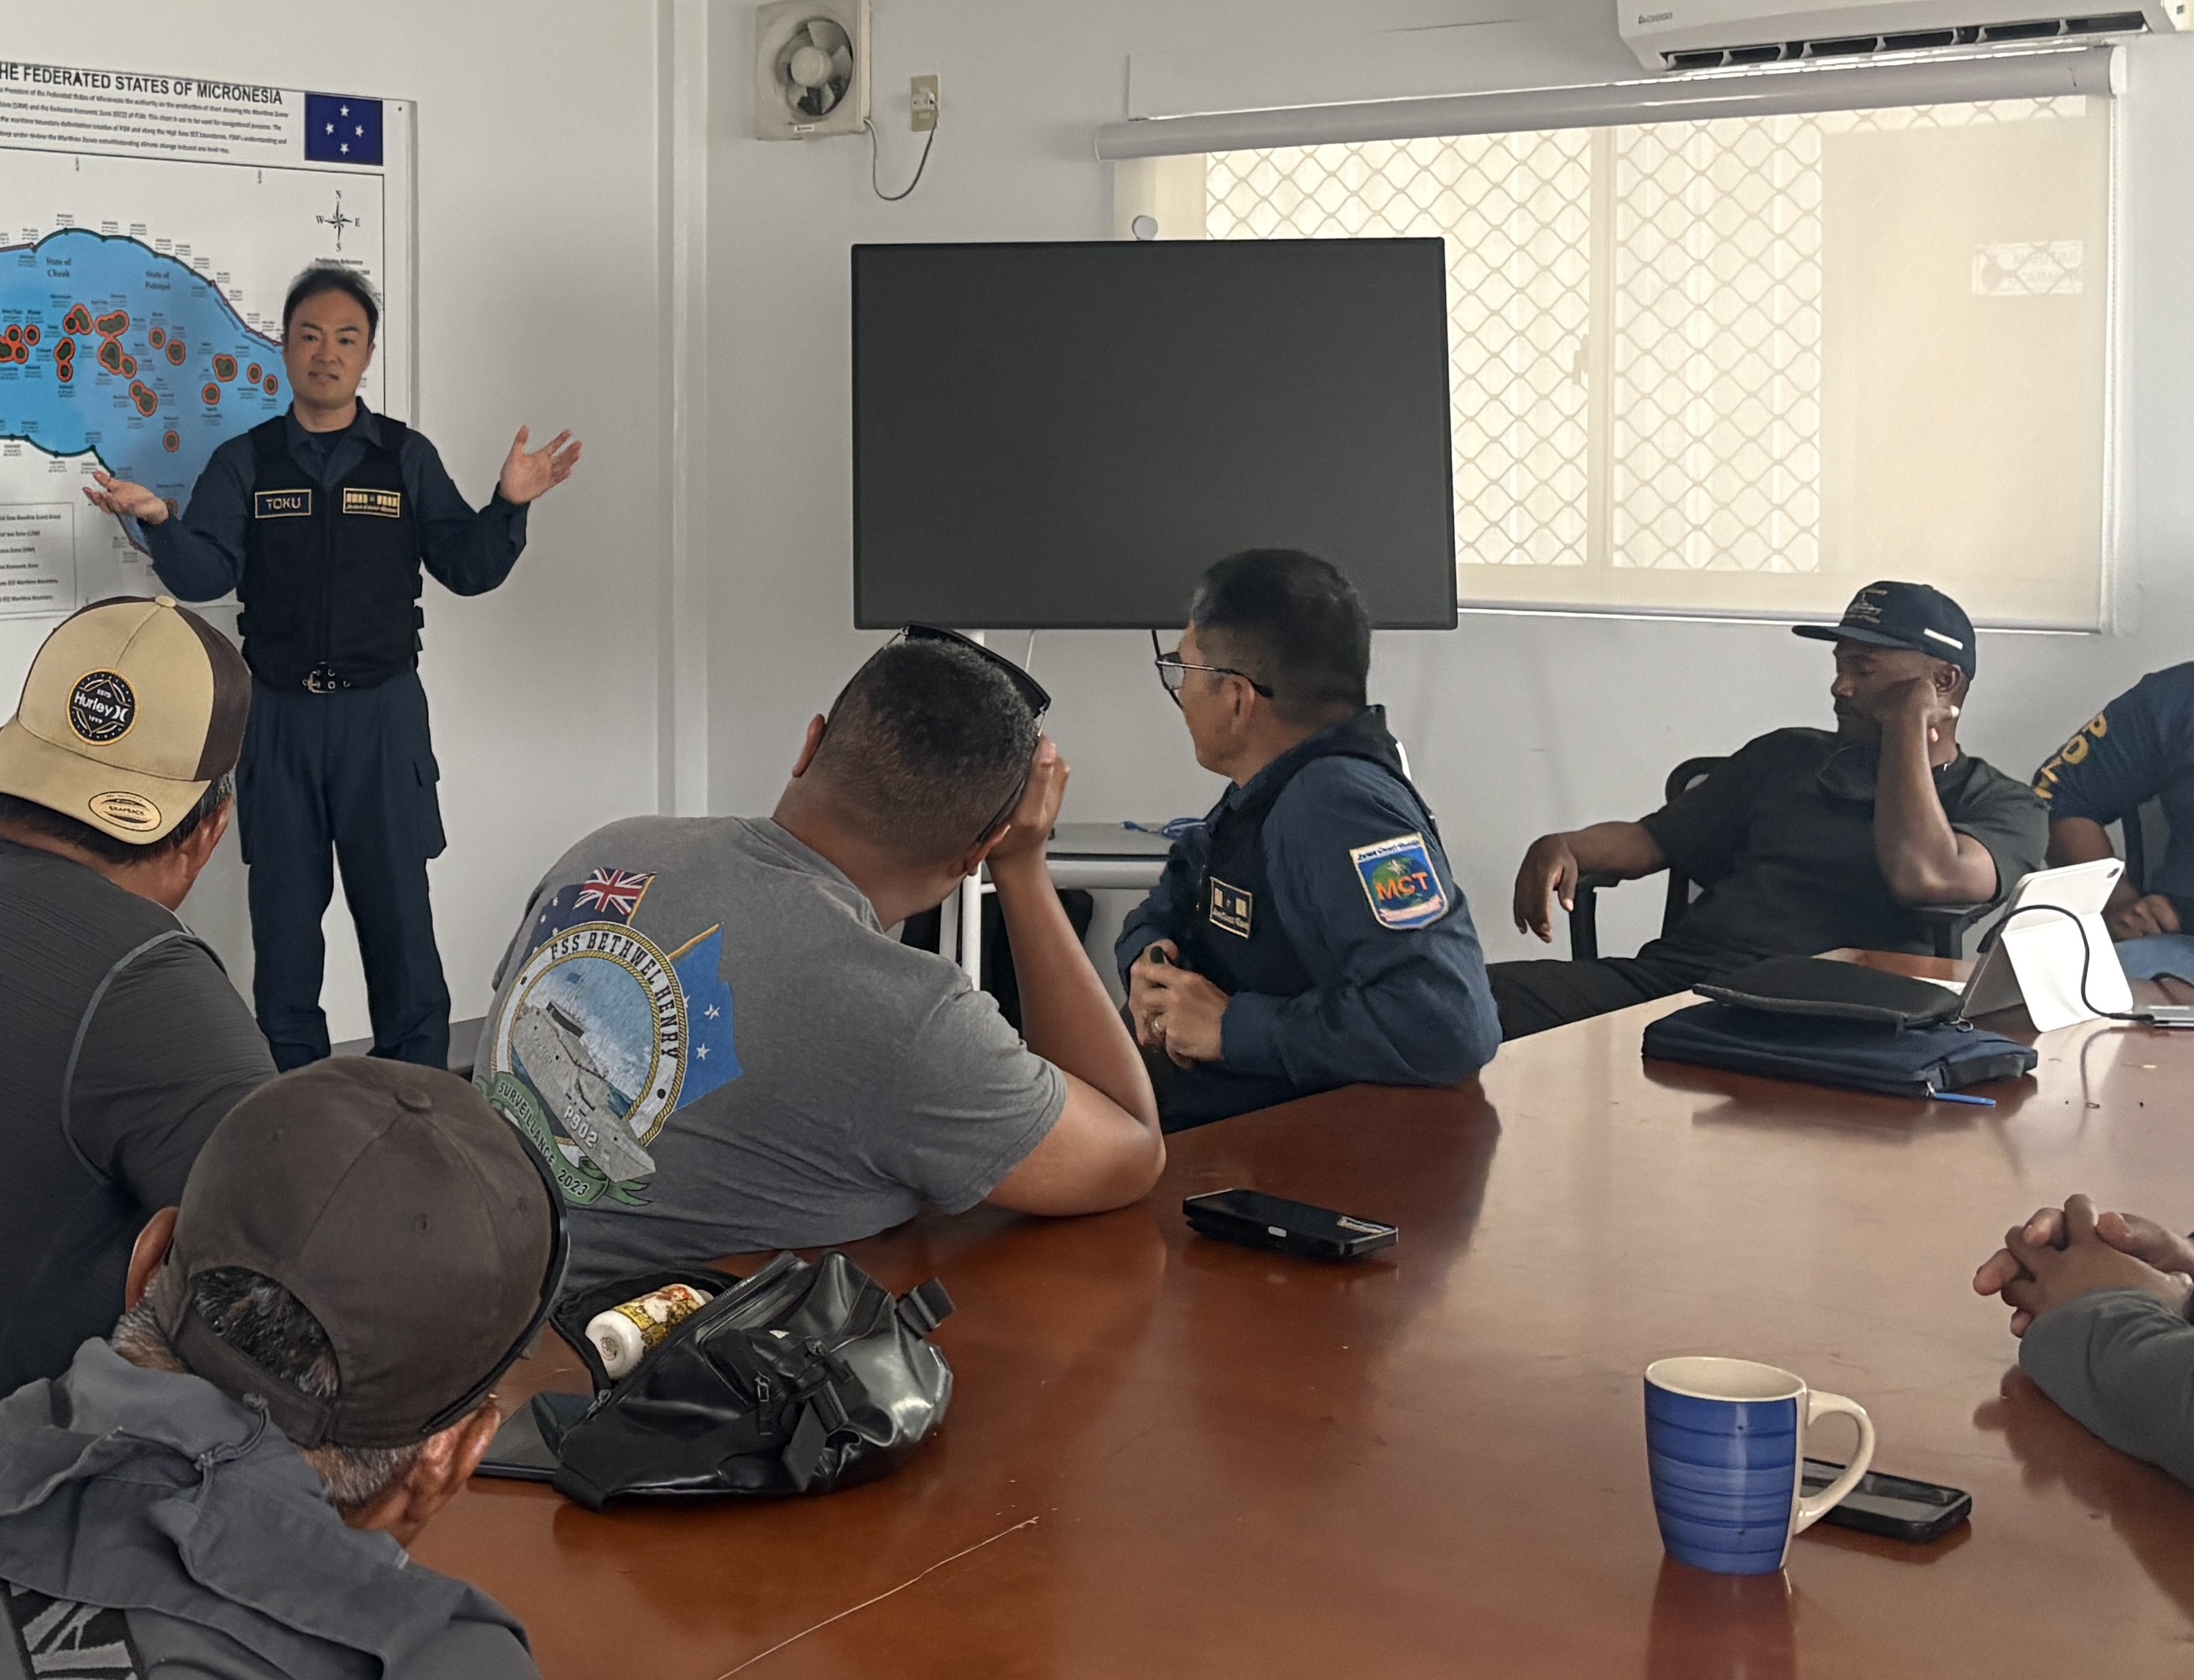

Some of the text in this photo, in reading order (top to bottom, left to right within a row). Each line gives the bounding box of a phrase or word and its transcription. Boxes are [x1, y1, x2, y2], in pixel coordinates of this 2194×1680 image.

[24, 66, 111, 89] FEDERATED
[116, 75, 169, 95] STATES
[173, 81, 192, 97] OF
[198, 83, 283, 104] MICRONESIA
[266, 497, 302, 510] TOKU
[74, 691, 114, 719] Hurley
[1376, 871, 1428, 902] MCT
[551, 932, 679, 1060] FSS BETHWEL HENRY
[563, 1105, 598, 1148] P902
[556, 1169, 590, 1196] 2023
